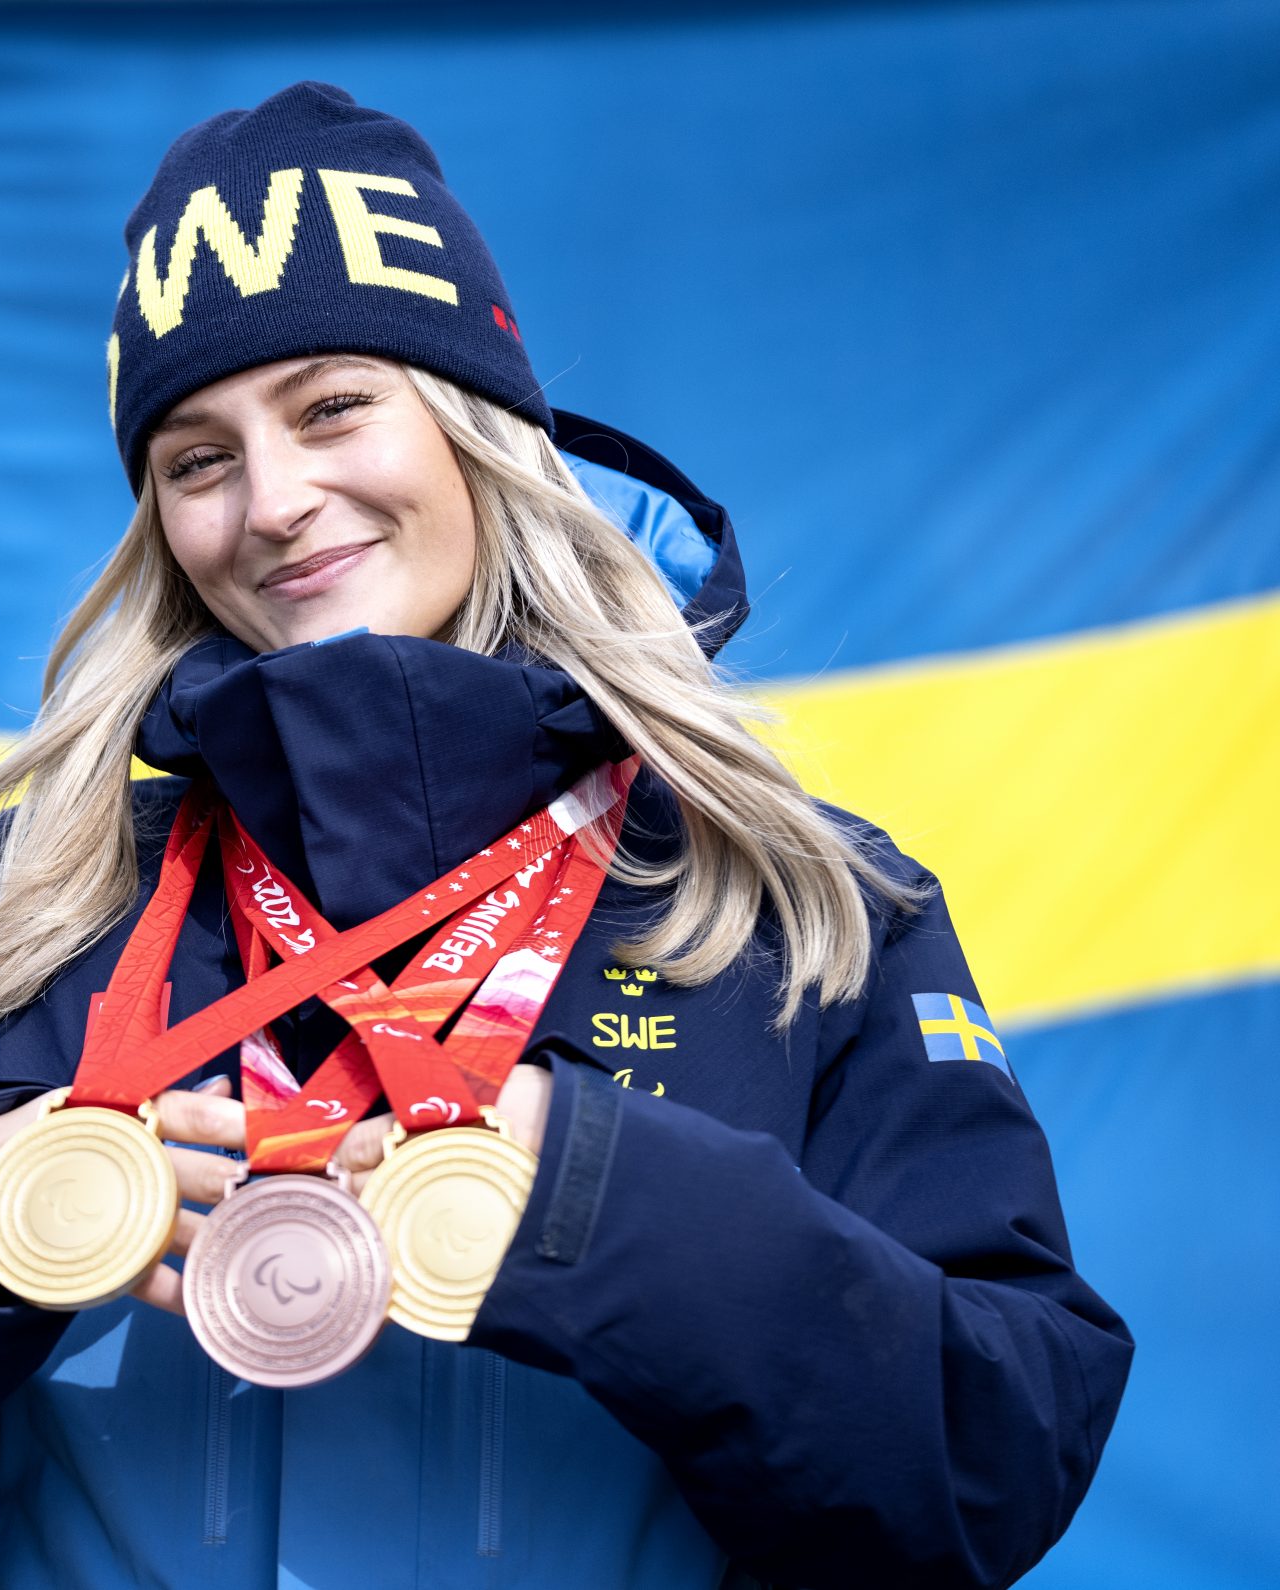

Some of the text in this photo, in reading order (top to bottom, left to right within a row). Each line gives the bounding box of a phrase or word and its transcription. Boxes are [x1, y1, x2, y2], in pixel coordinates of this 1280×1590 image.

[107, 167, 458, 432] WE
[421, 890, 520, 973] BEIJING
[592, 1013, 677, 1050] SWE
